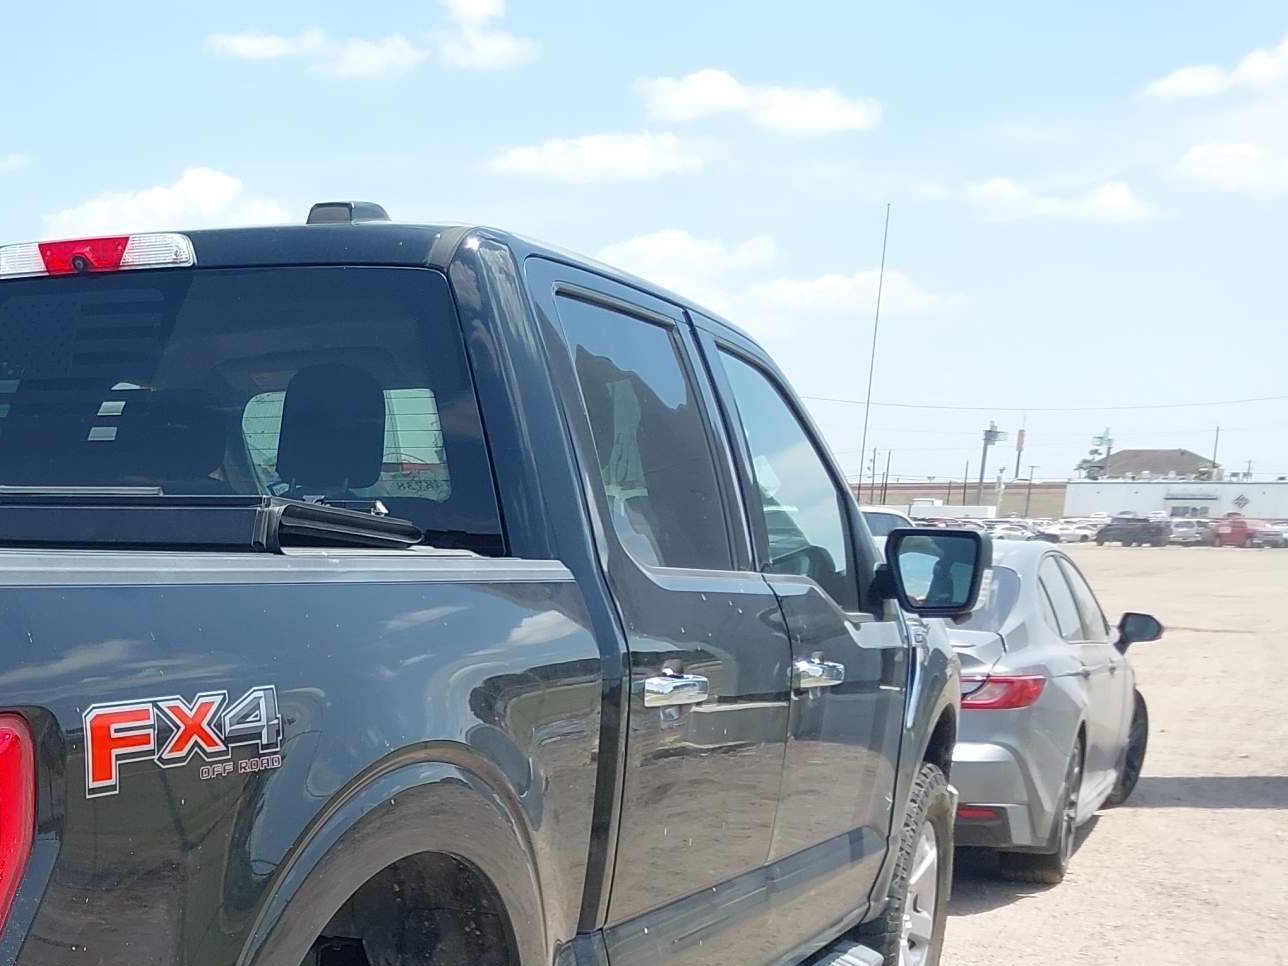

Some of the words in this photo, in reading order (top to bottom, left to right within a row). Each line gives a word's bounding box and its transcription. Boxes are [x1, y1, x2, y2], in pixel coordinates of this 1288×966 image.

[82, 685, 283, 799] FX4
[199, 761, 234, 780] OFF
[239, 753, 282, 774] ROAD
